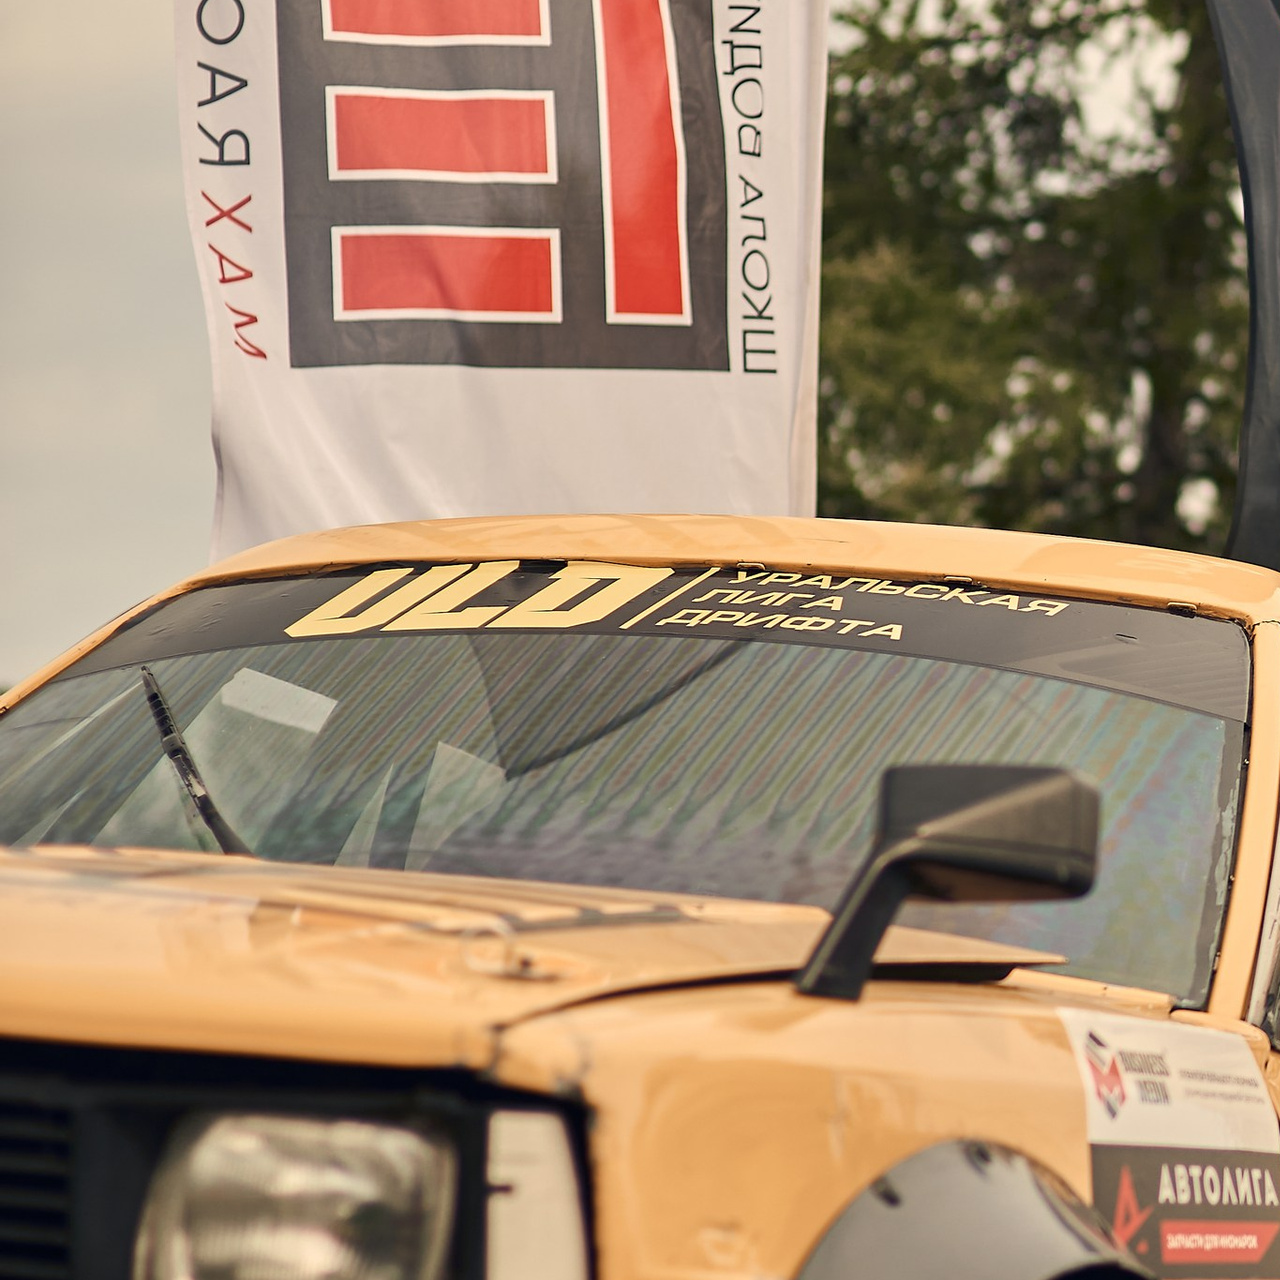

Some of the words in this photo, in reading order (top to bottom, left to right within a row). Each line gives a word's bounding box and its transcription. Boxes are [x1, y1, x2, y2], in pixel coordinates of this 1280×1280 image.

[692, 589, 844, 612] ЛИГА
[728, 571, 1070, 617] УРАЛЬСКАЯ
[654, 609, 904, 641] ДРИФТА
[1158, 1163, 1280, 1207] АВТОЛИГА
